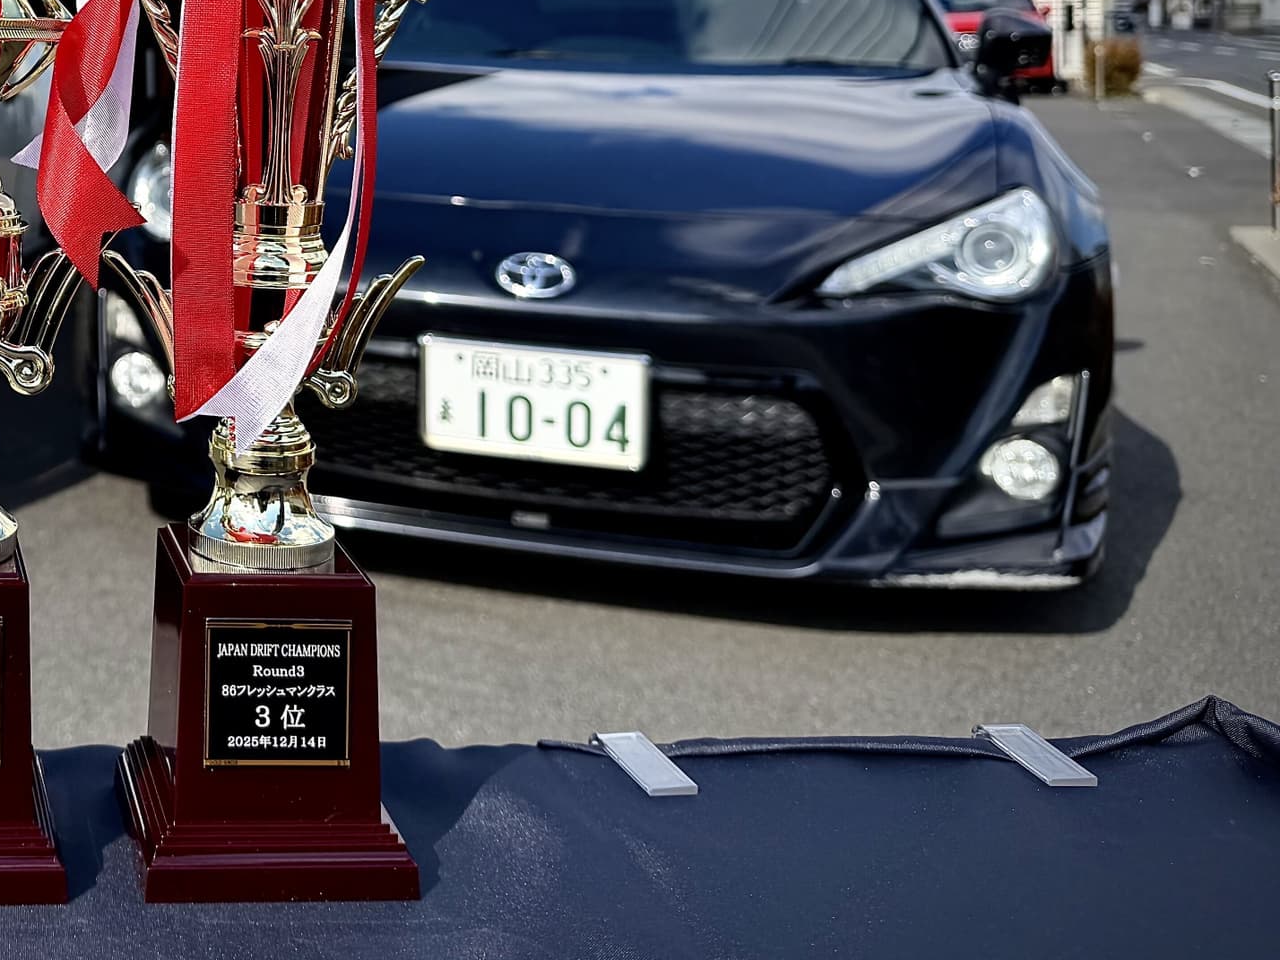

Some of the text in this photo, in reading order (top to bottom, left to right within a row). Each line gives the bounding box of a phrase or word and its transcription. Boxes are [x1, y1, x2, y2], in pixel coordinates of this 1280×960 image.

[479, 391, 630, 453] 10-04
[217, 643, 341, 658] JAPAN DRIFT CHAMPIONS
[252, 665, 305, 677] Round3
[221, 685, 336, 698] 86フレッシュマンクラス
[227, 735, 327, 749] 2025年12月14日
